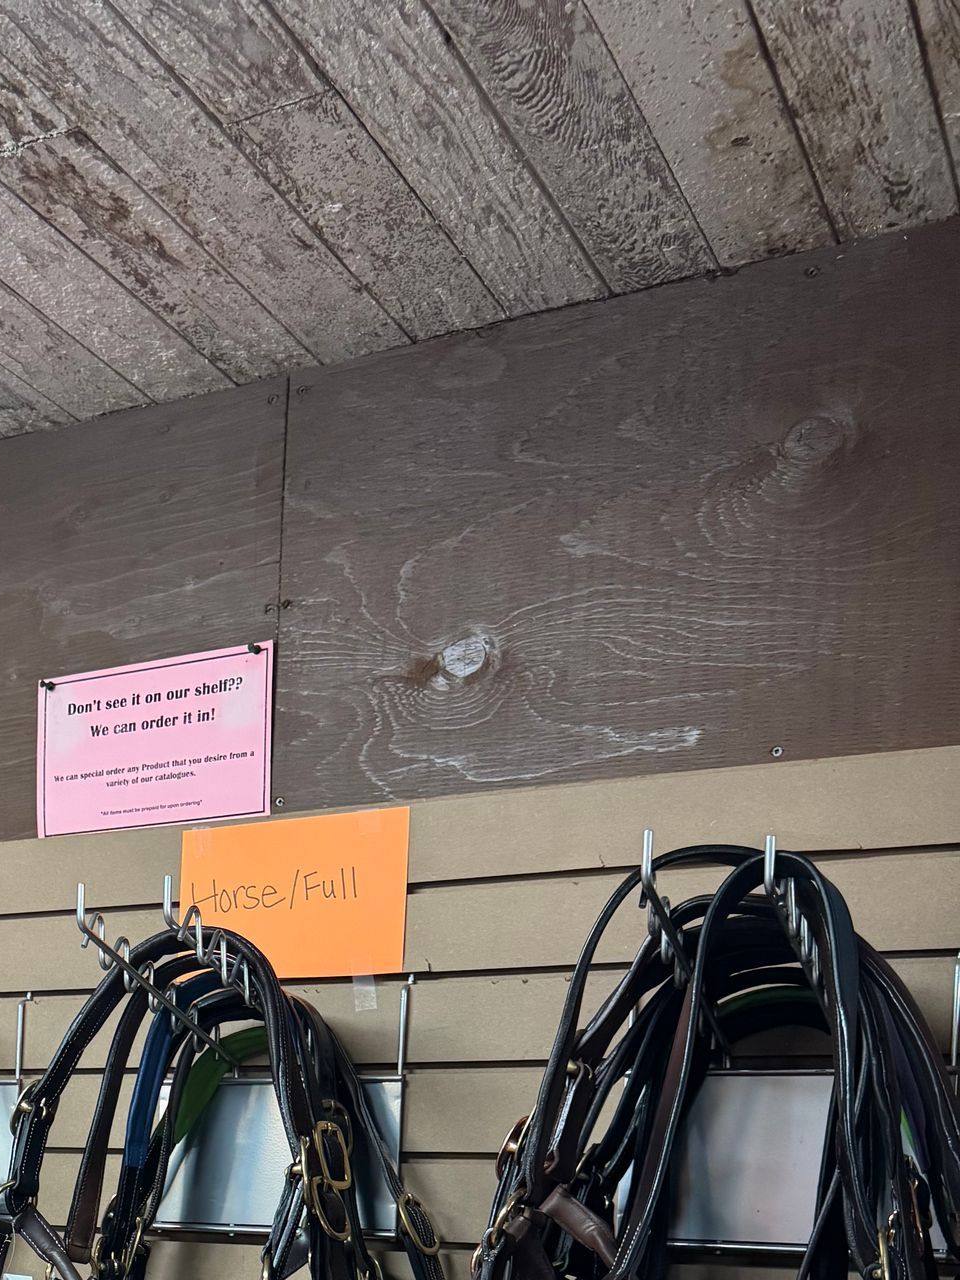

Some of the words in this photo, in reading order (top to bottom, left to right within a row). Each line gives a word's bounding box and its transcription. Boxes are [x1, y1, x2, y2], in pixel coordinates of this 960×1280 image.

[68, 700, 101, 715] Don't
[105, 698, 127, 710] see
[132, 693, 141, 706] it
[145, 692, 162, 704] on
[166, 687, 190, 701] our
[194, 676, 243, 697] shelf??
[90, 724, 109, 737] We
[113, 722, 136, 735] can
[141, 715, 178, 730] order
[183, 712, 192, 725] it
[197, 708, 216, 723] in!
[54, 774, 64, 783] We
[80, 769, 104, 780] special
[106, 767, 125, 776] order
[127, 766, 140, 775] any
[142, 760, 170, 771] Product
[172, 758, 187, 768] that
[189, 757, 202, 766] you
[204, 753, 227, 763] desire
[229, 751, 248, 760] from
[106, 778, 129, 787] variety
[131, 776, 139, 784] of
[140, 775, 153, 783] our
[155, 770, 196, 781] catalogues.
[191, 866, 358, 913] Horse/Full
